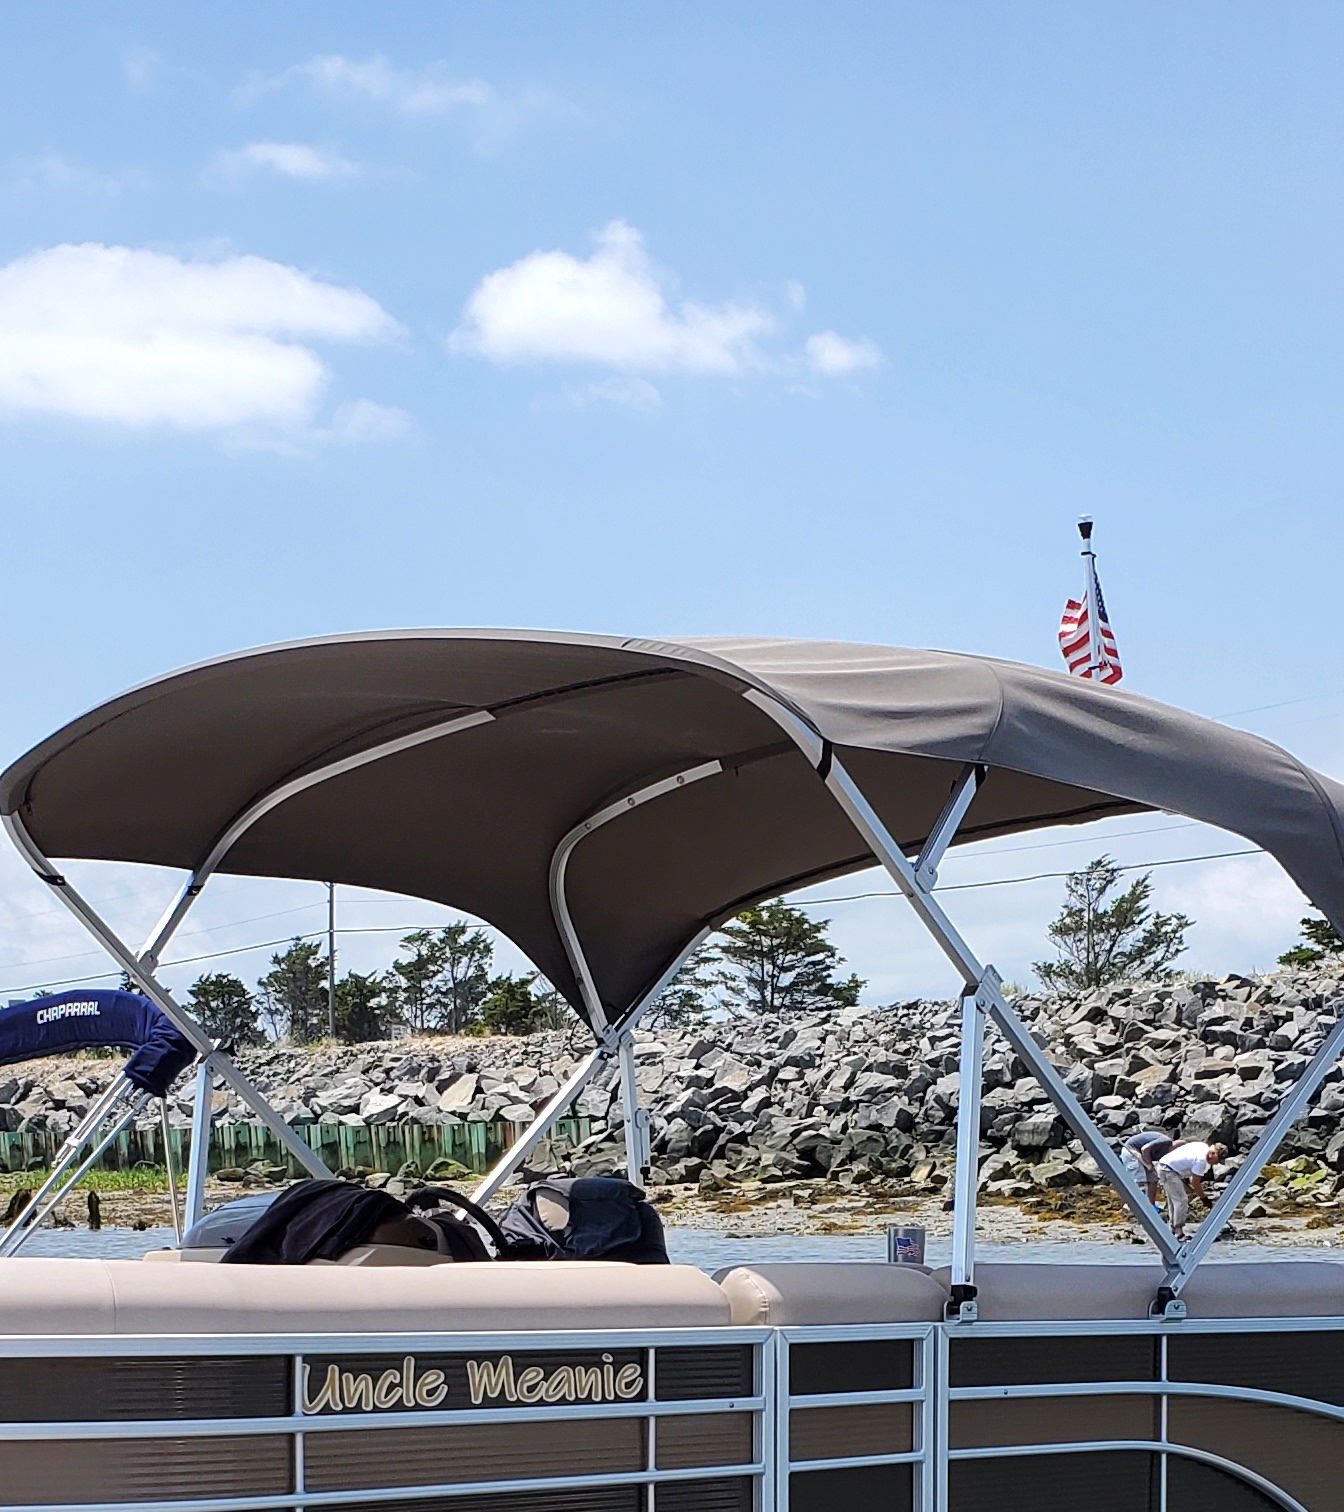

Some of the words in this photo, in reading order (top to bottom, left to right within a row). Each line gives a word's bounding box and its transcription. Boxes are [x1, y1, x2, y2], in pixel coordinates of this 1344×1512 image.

[36, 1001, 101, 1024] CHAPARRAL
[301, 1356, 448, 1415] Uncle
[467, 1353, 644, 1404] Meanie
